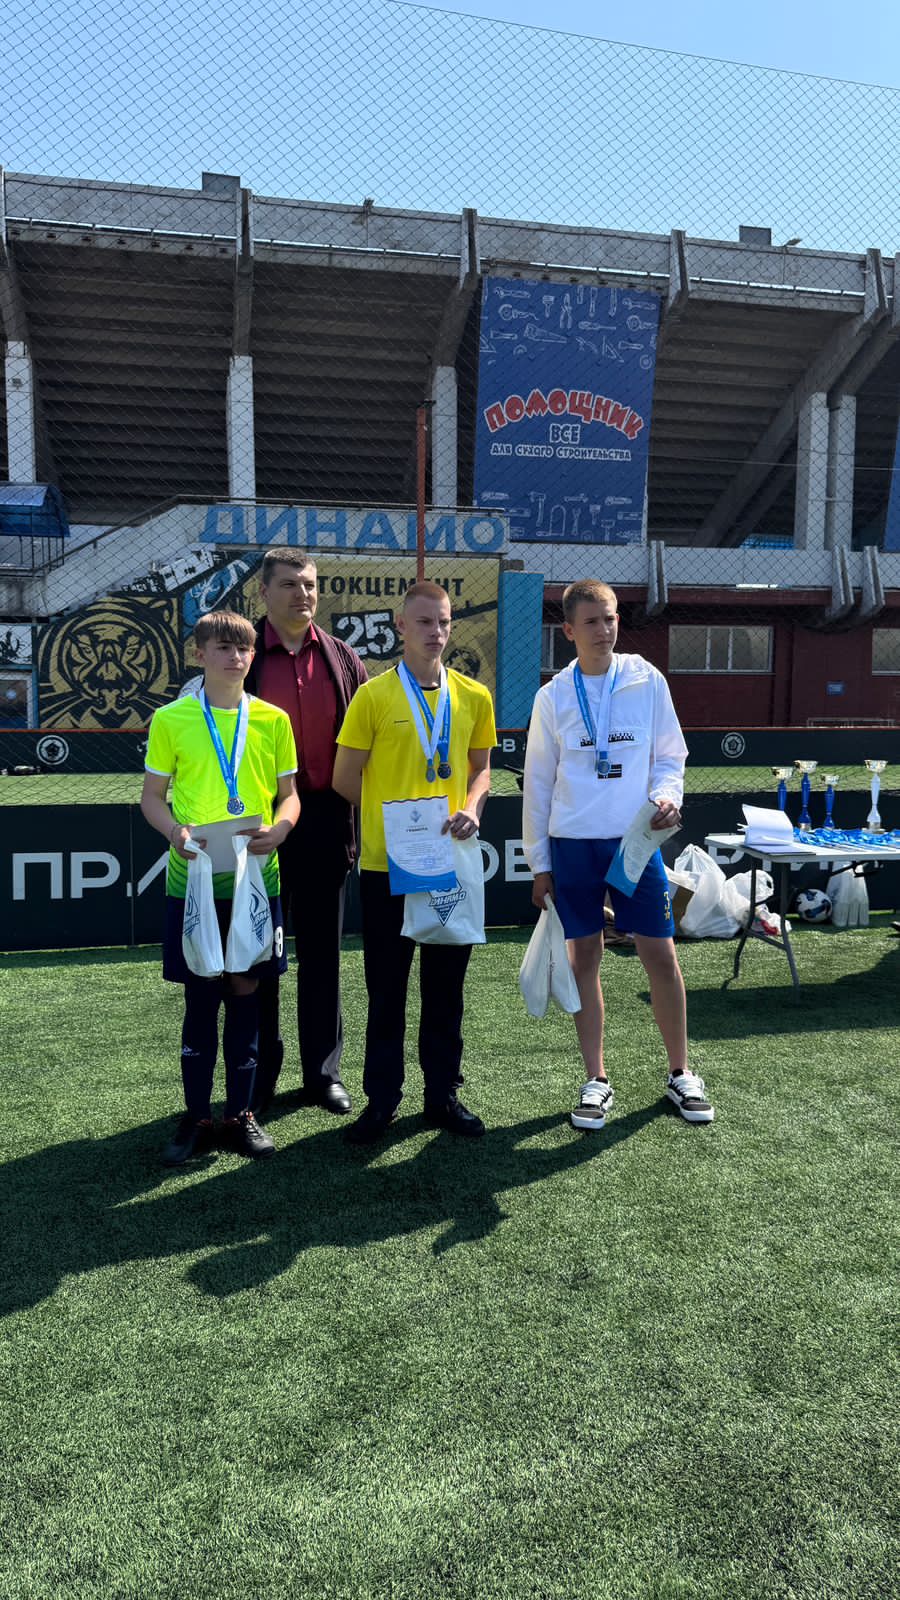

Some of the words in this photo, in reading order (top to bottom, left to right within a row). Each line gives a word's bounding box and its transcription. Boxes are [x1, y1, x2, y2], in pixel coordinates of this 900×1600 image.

[484, 388, 646, 440] ПОМОЩНИК
[549, 423, 582, 444] ВСЕ
[490, 443, 513, 456] ДЛЯ
[515, 444, 554, 459] СУХОГО
[556, 447, 632, 461] СТРОИТЕЛЬСТВА
[198, 504, 506, 553] ДИНАМО
[336, 611, 396, 657] 25
